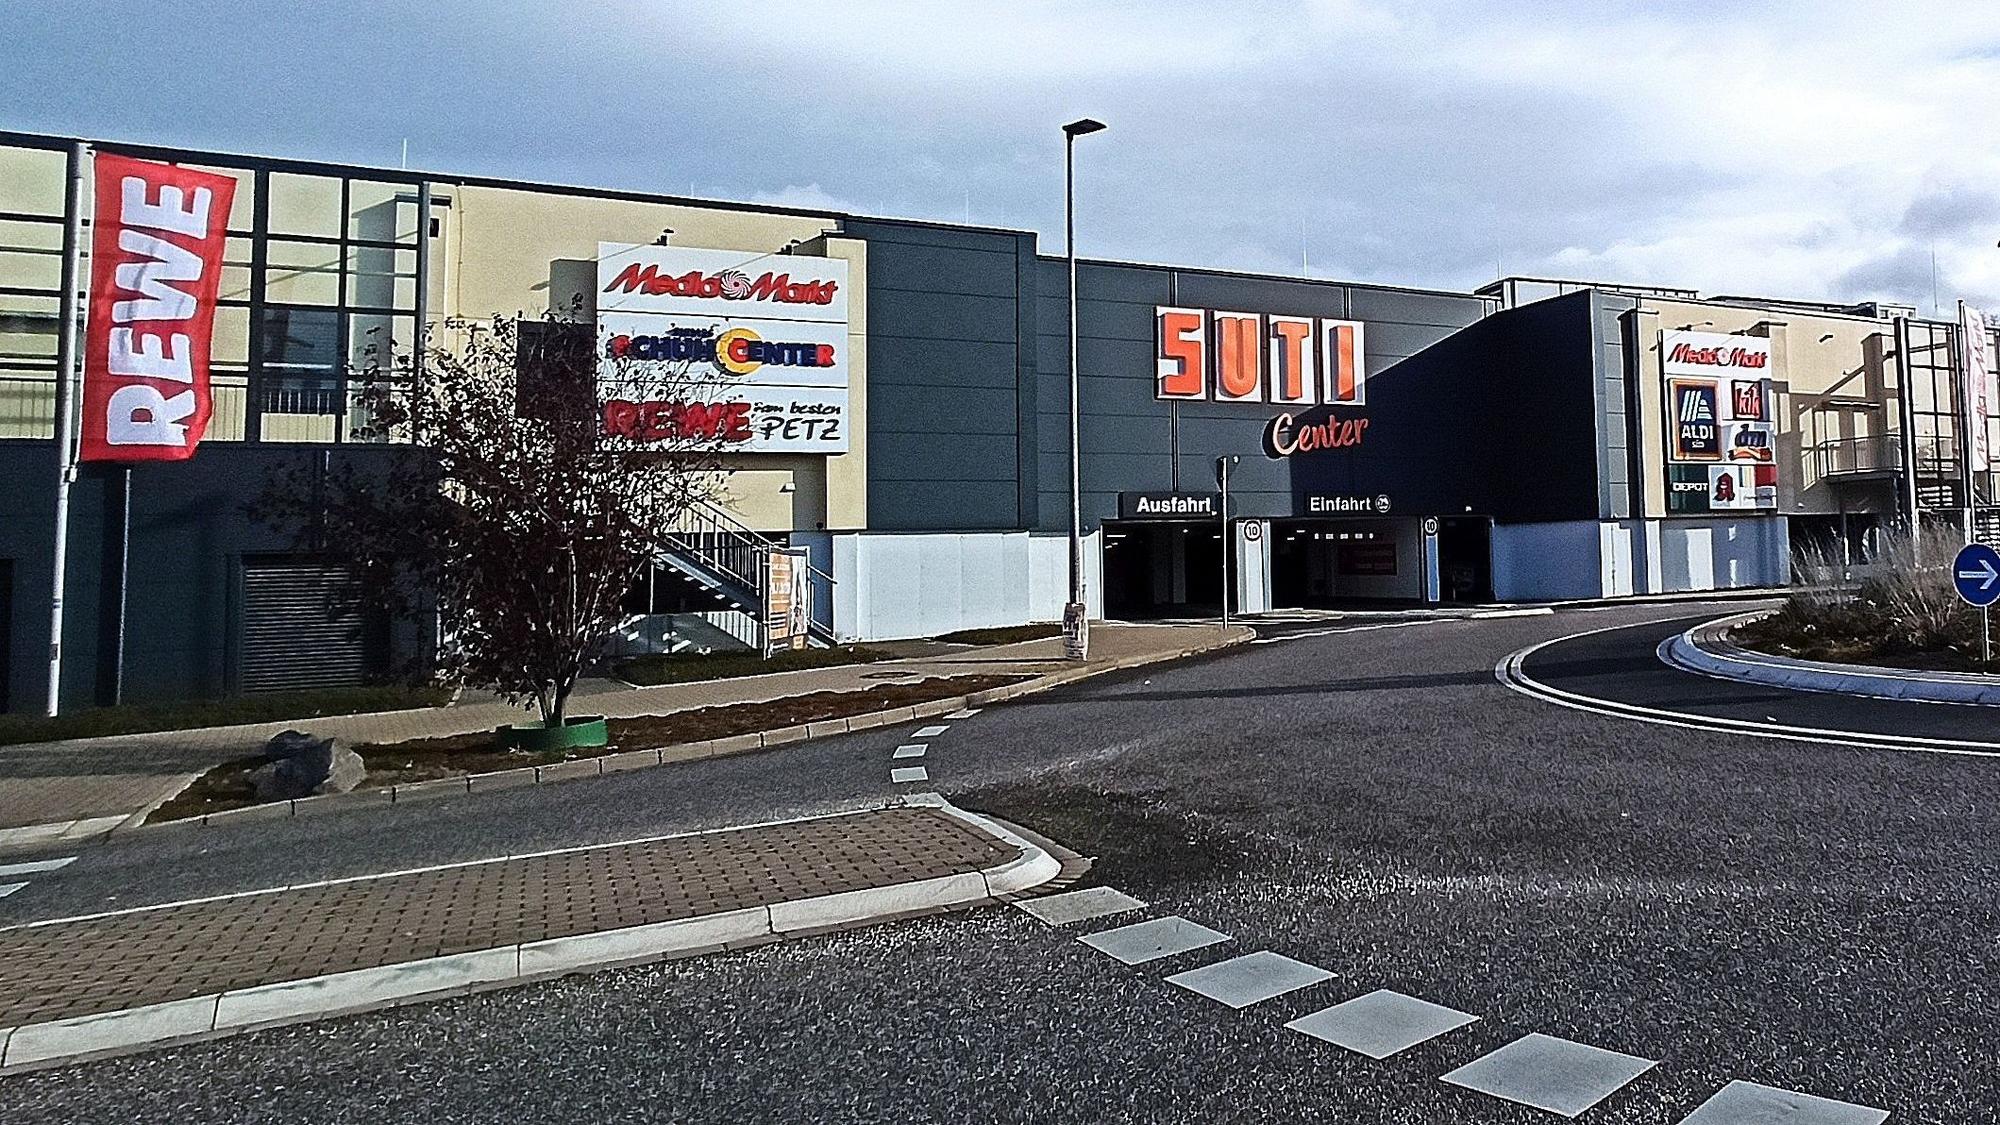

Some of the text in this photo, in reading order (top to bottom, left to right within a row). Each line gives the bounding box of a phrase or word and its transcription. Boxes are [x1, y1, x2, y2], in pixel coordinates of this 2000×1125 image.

[602, 263, 839, 306] Media Markt
[106, 176, 213, 446] REWE
[1161, 312, 1356, 401] SUTI
[1666, 343, 1769, 369] Media Markt
[790, 401, 841, 415] besten
[603, 400, 753, 442] REWE
[760, 416, 841, 441] PETZ
[1681, 424, 1714, 440] ALDI
[1270, 412, 1370, 456] Center
[1672, 482, 1708, 492] DEPOT
[1136, 497, 1211, 512] Ausfahrt
[1310, 497, 1372, 512] Einfahrt
[1248, 526, 1258, 537] 10
